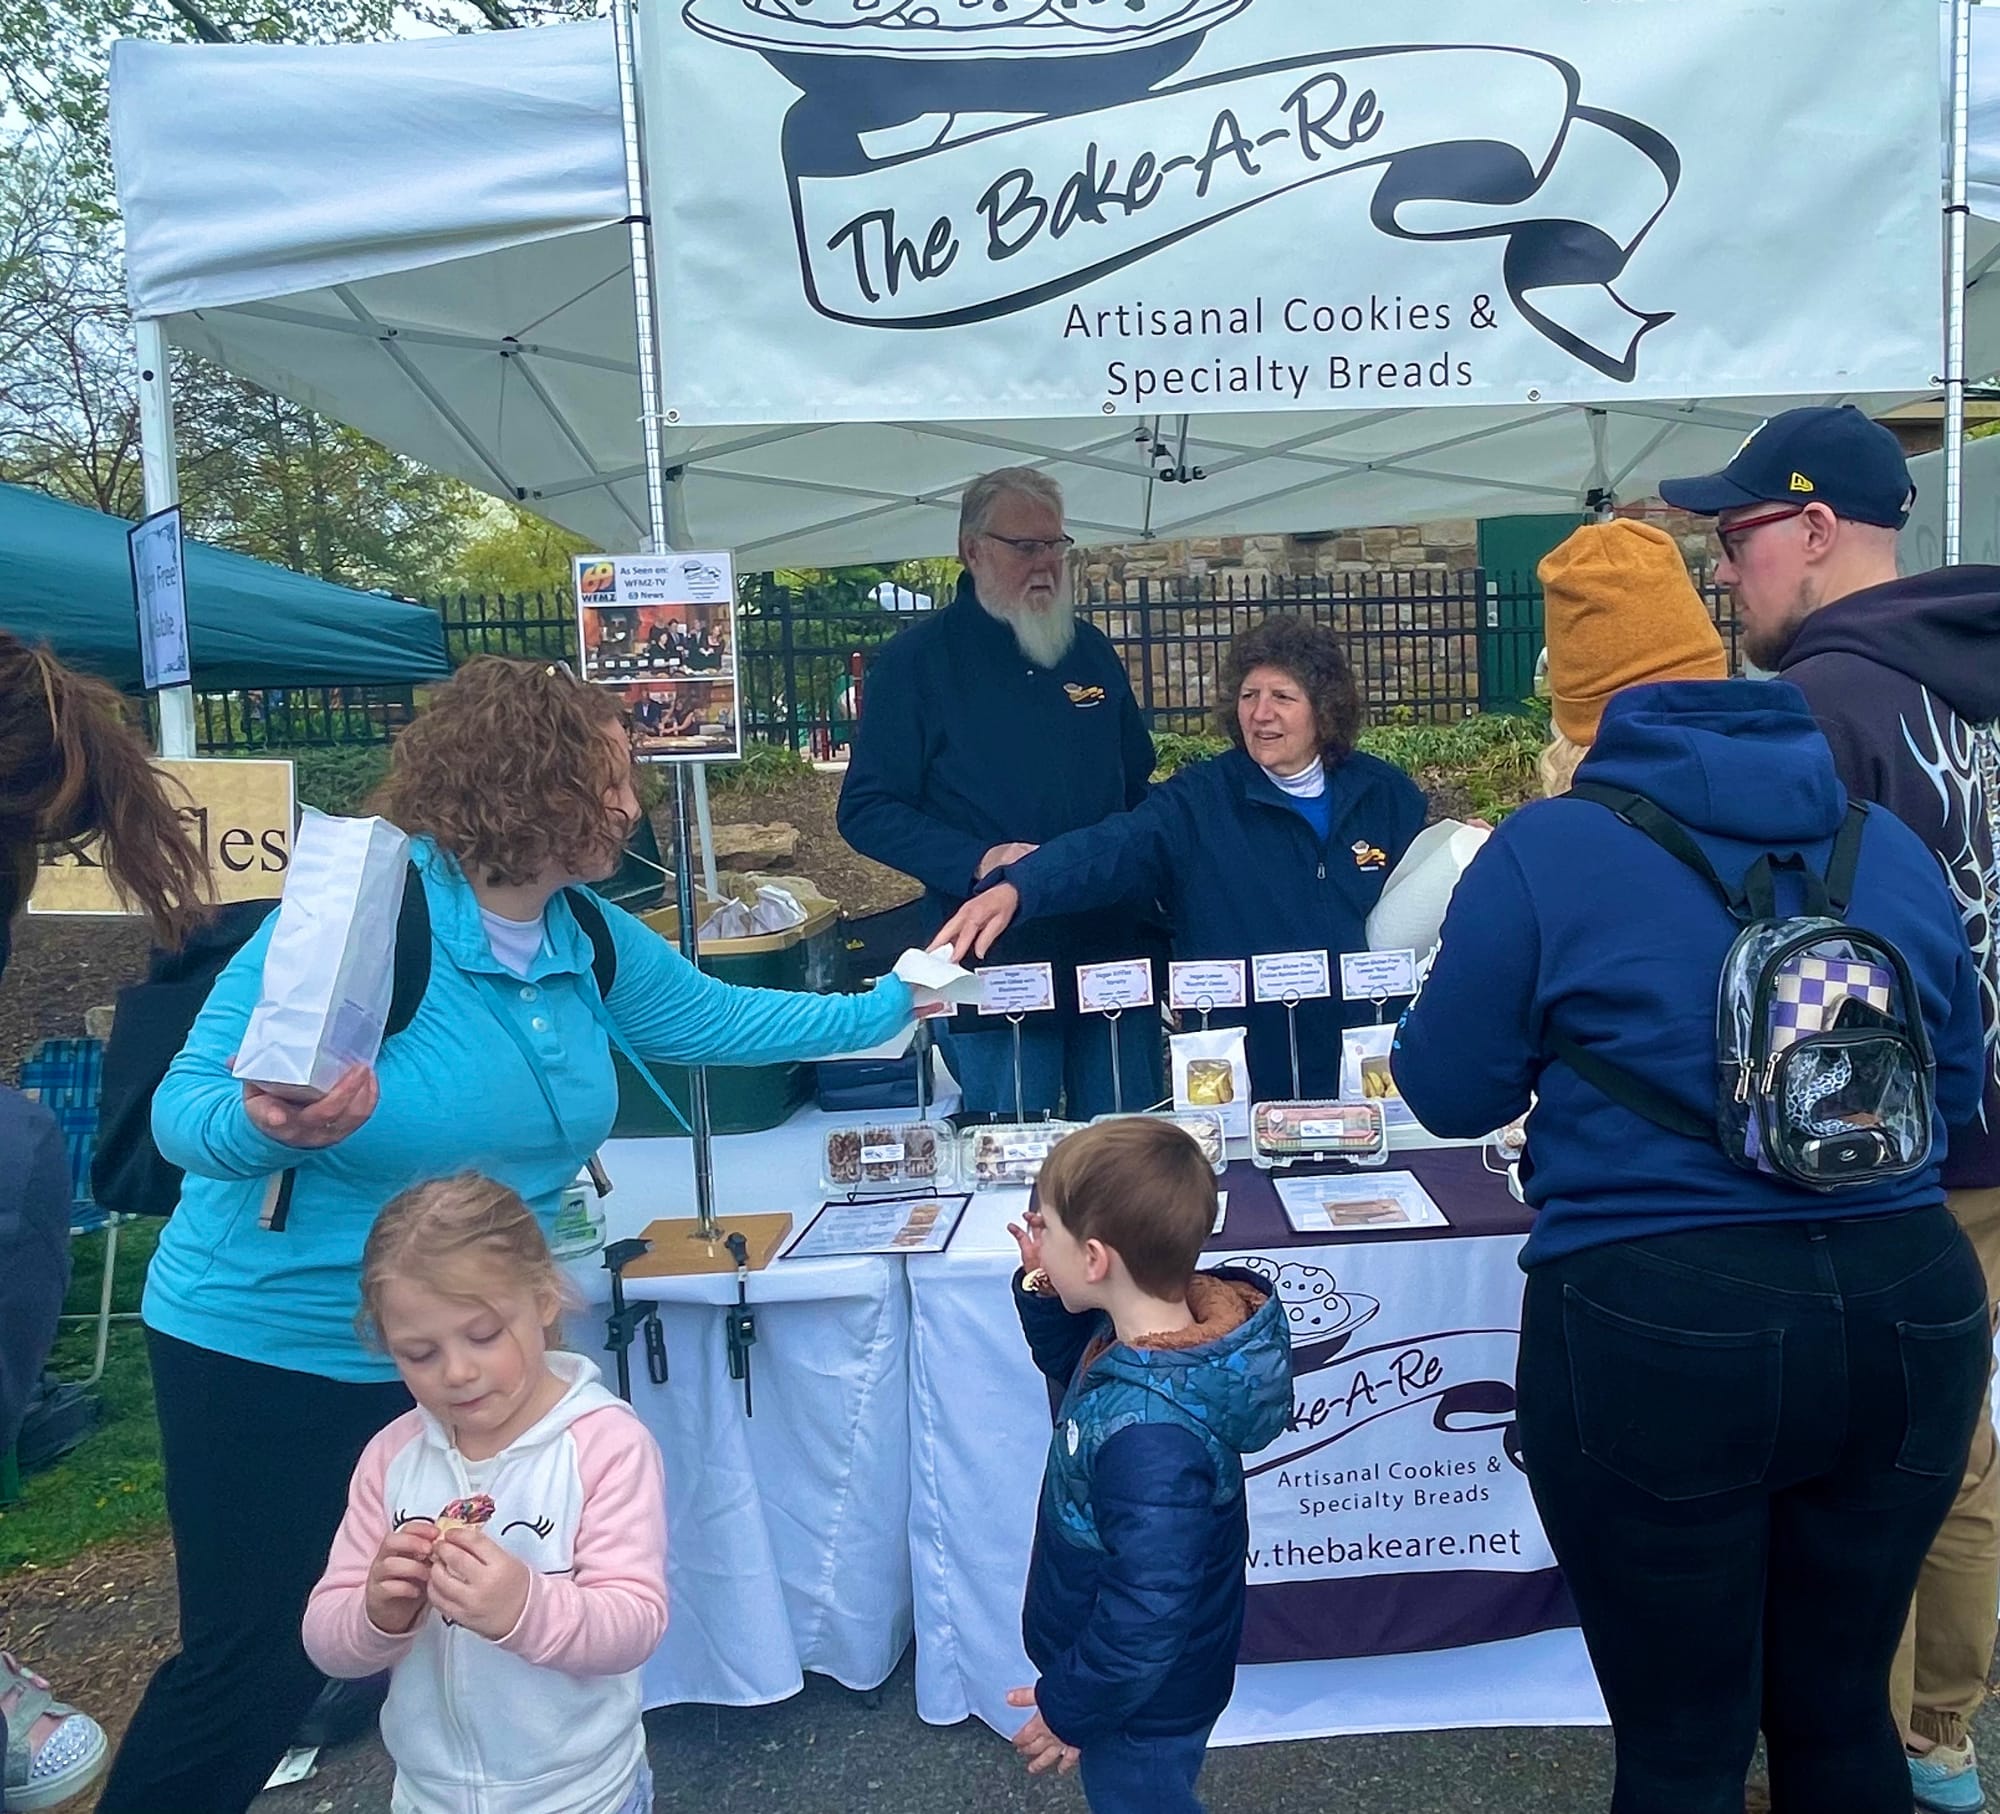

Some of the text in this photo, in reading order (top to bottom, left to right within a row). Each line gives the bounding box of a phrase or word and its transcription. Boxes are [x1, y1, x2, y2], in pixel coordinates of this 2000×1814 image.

[827, 72, 1384, 304] The Bake-A-Re
[1063, 293, 1498, 338] Artisanal Cookies &
[1107, 351, 1472, 404] Specialty Breads
[620, 567, 630, 575] As
[632, 566, 653, 575] Seen
[624, 578, 667, 588] WFMZ-TV
[581, 592, 617, 603] WFMZ
[641, 590, 665, 599] News
[1287, 1348, 1444, 1433] ke-A-Re
[1277, 1455, 1501, 1488] Artisanal Cookies &
[1299, 1484, 1489, 1518] Specialty Breads
[1245, 1529, 1521, 1569] w.thebakeare.net
